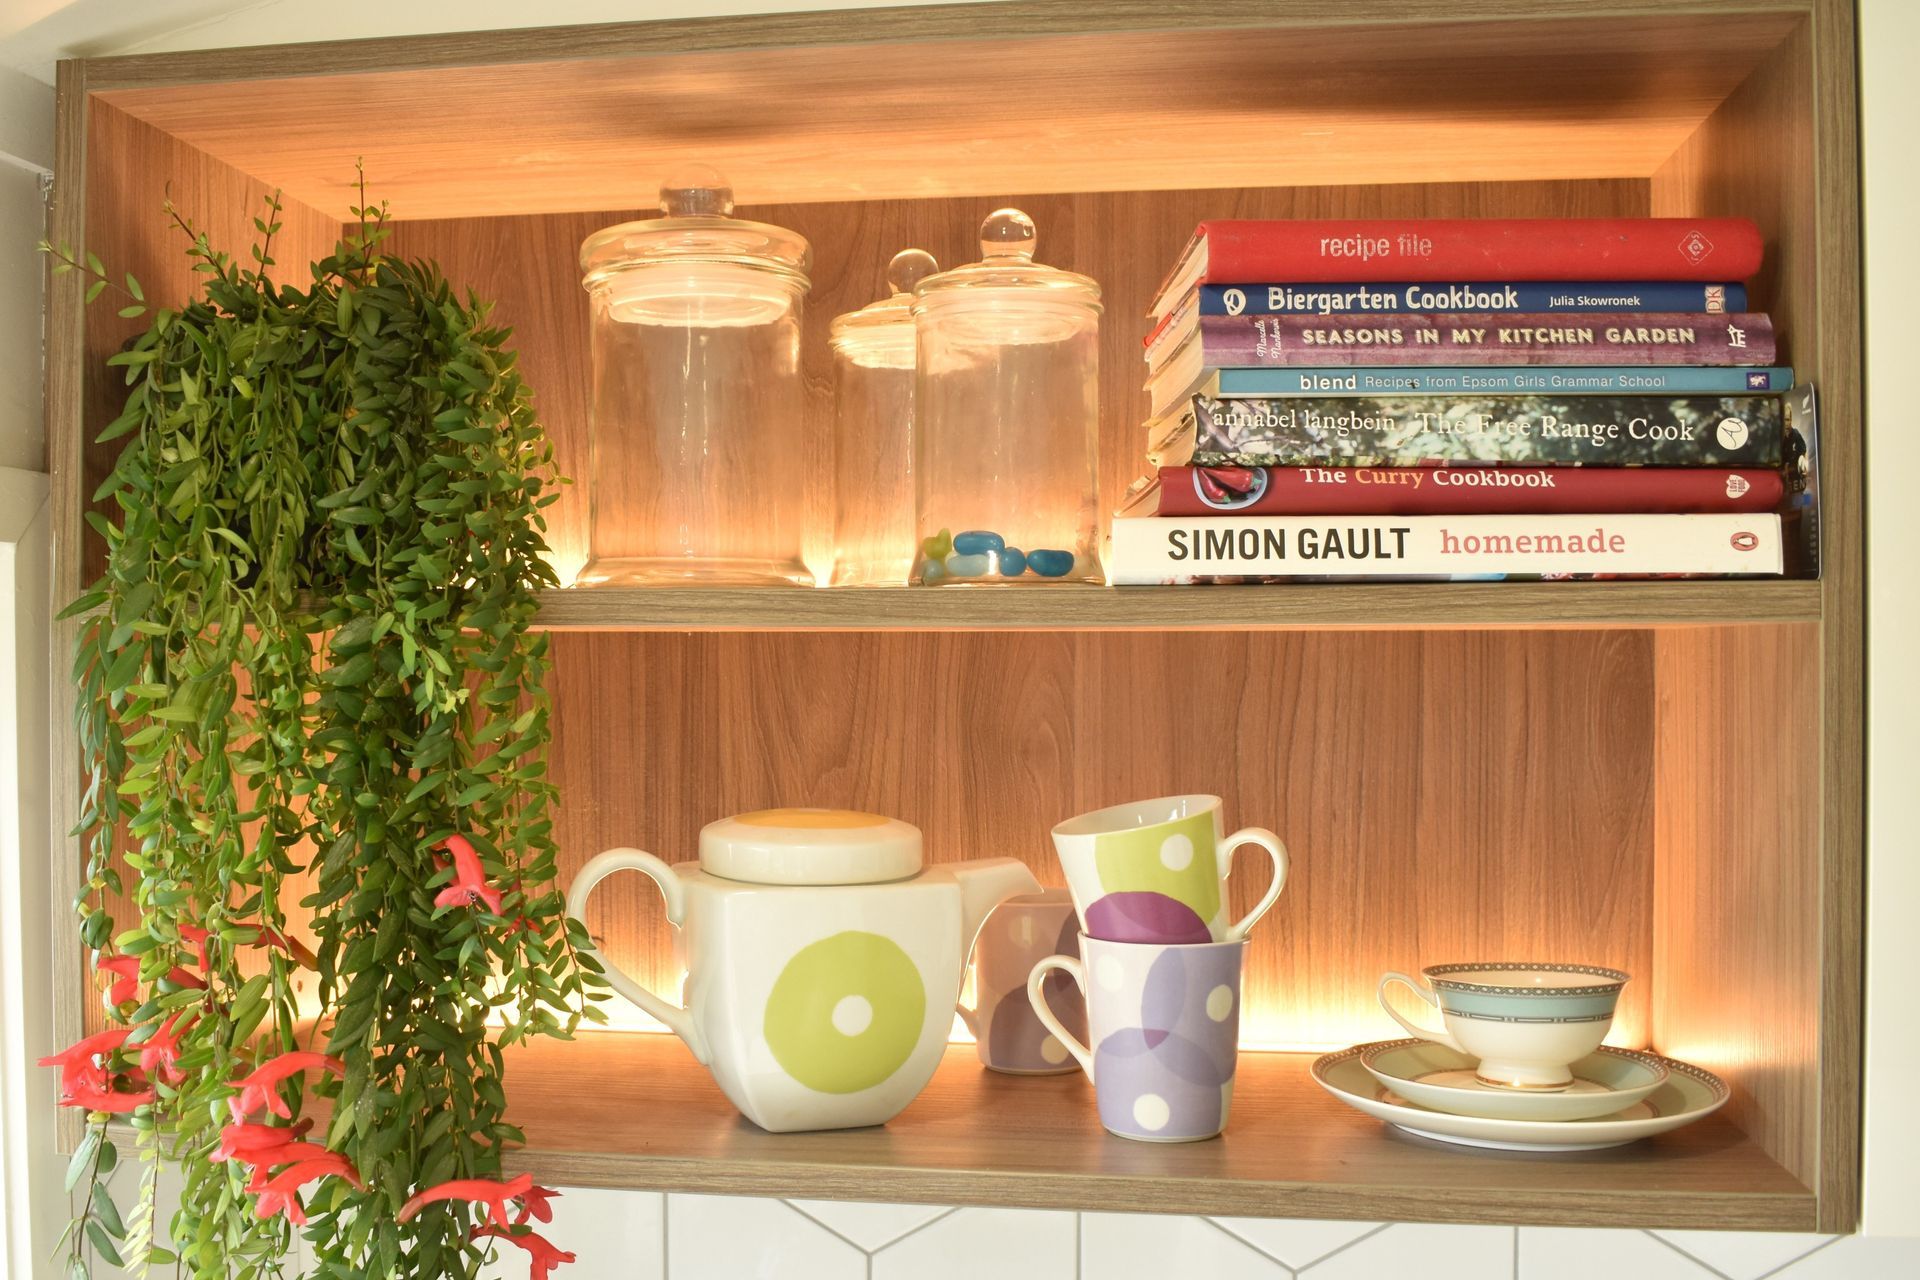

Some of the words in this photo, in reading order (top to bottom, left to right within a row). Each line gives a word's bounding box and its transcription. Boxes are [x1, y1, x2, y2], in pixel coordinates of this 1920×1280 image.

[1320, 234, 1390, 261] recipe
[1398, 233, 1433, 257] file
[1268, 286, 1398, 315] Biergarten
[1405, 285, 1519, 310] Cookbook
[1550, 295, 1575, 307] Julia
[1577, 295, 1641, 307] Skowronek
[1707, 288, 1722, 312] DK
[1254, 319, 1267, 357] Marcelle
[1302, 328, 1403, 345] SEASONS
[1416, 329, 1440, 345] IN
[1451, 328, 1486, 344] MY
[1499, 327, 1595, 344] KITCHEN
[1605, 327, 1696, 344] GARDEN
[1300, 375, 1357, 390] blend
[1365, 376, 1420, 389] Recipes
[1426, 376, 1457, 388] from
[1462, 376, 1509, 389] Epsom
[1513, 375, 1546, 388] Girls
[1551, 375, 1615, 388] Grammar
[1618, 375, 1666, 388] School
[1213, 409, 1297, 428] annabel
[1304, 409, 1396, 437] langbein
[1415, 412, 1466, 434] The
[1475, 414, 1531, 437] Free
[1541, 415, 1619, 446] Range
[1628, 418, 1695, 441] Cook
[1299, 468, 1347, 484] The
[1355, 469, 1425, 489] Curry
[1432, 470, 1556, 488] Cookbook
[1168, 528, 1286, 561] SIMON
[1297, 527, 1411, 561] GAULT
[1440, 528, 1626, 554] homemade
